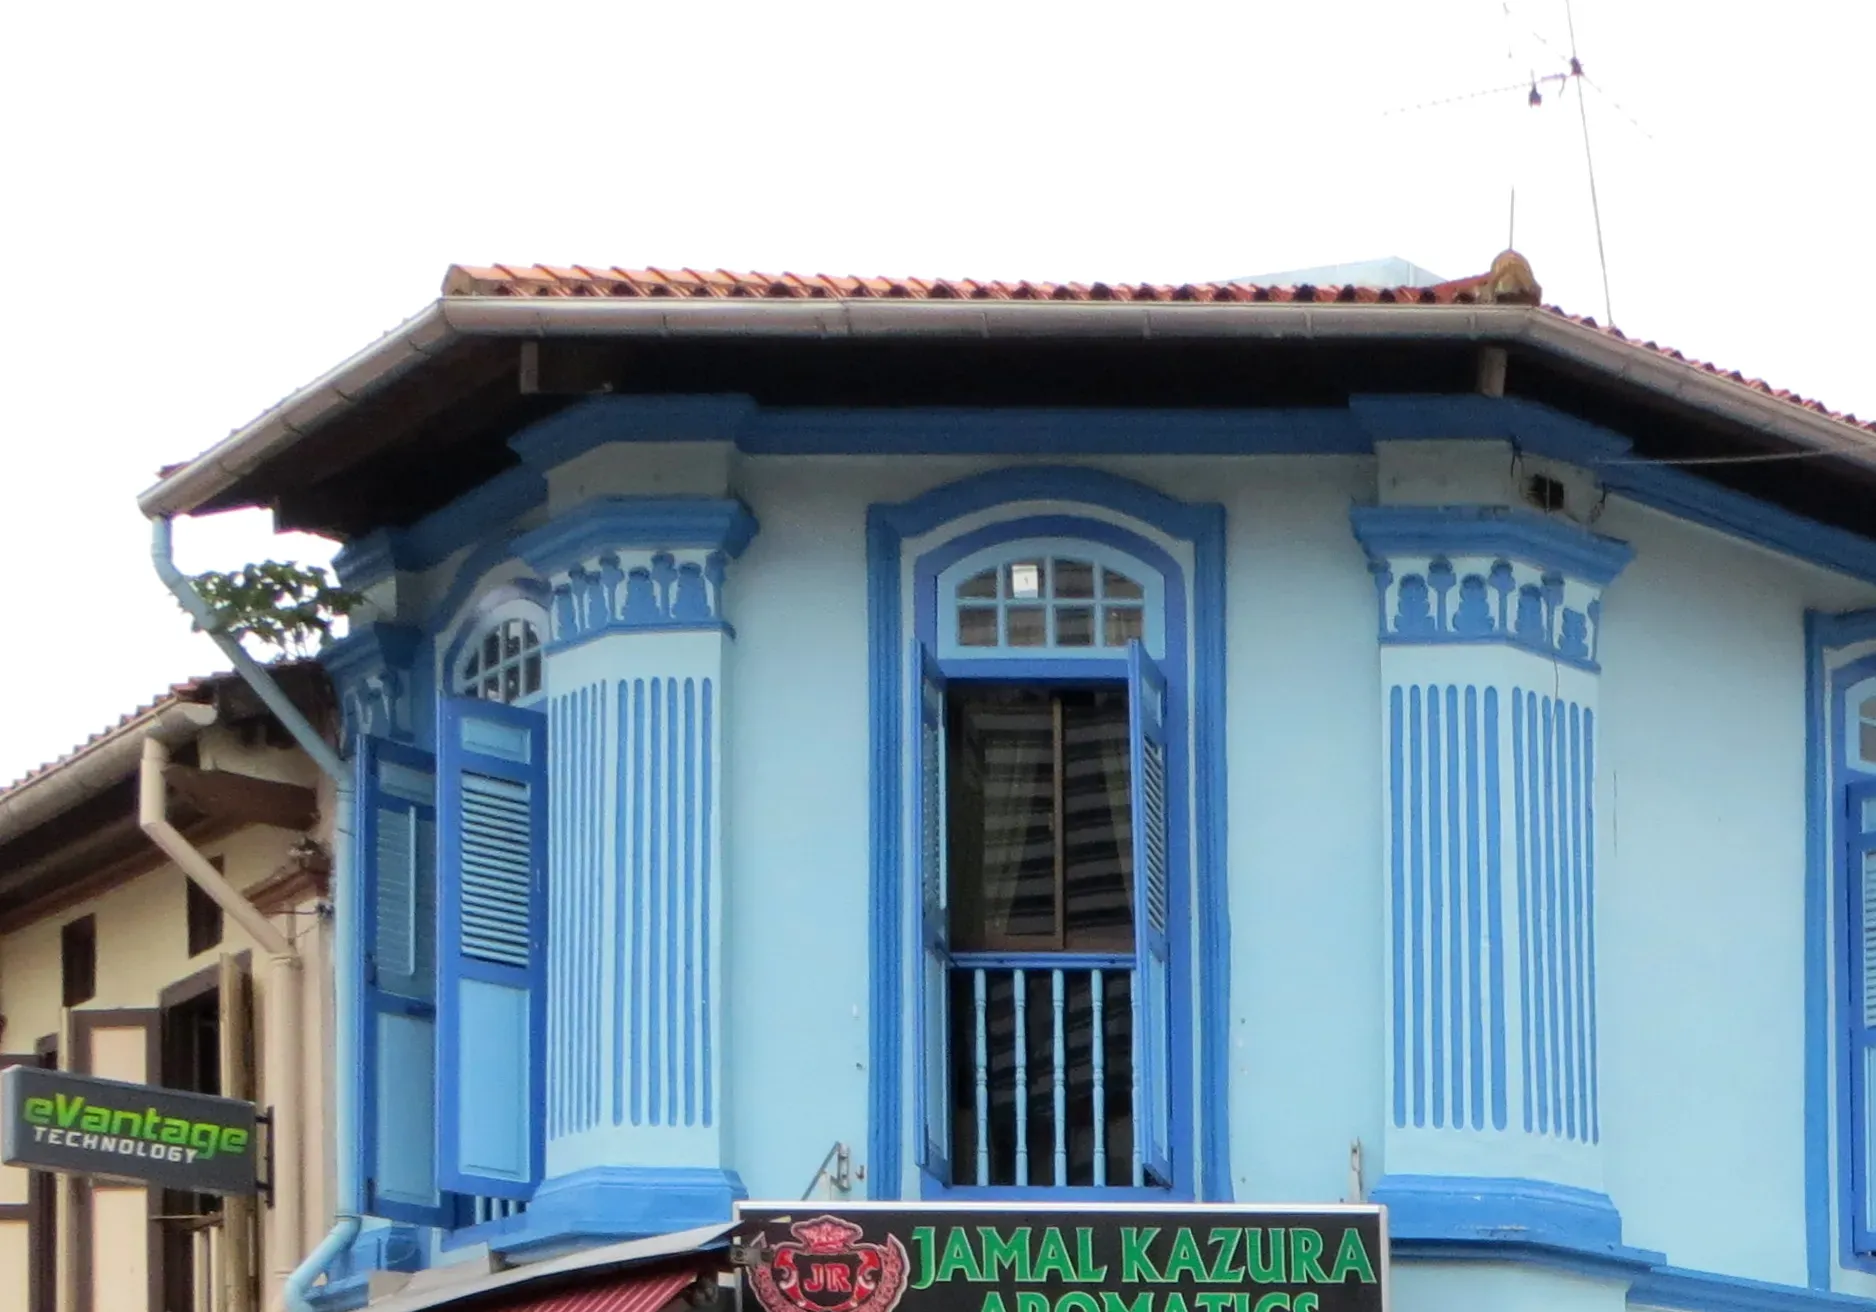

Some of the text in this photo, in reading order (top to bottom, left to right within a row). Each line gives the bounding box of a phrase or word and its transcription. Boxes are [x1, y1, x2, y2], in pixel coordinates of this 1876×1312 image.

[23, 1093, 248, 1160] eVantage
[33, 1126, 199, 1164] TECHNOLOGY
[803, 1262, 853, 1293] JR
[911, 1226, 1377, 1289] JAMAL KAZURA
